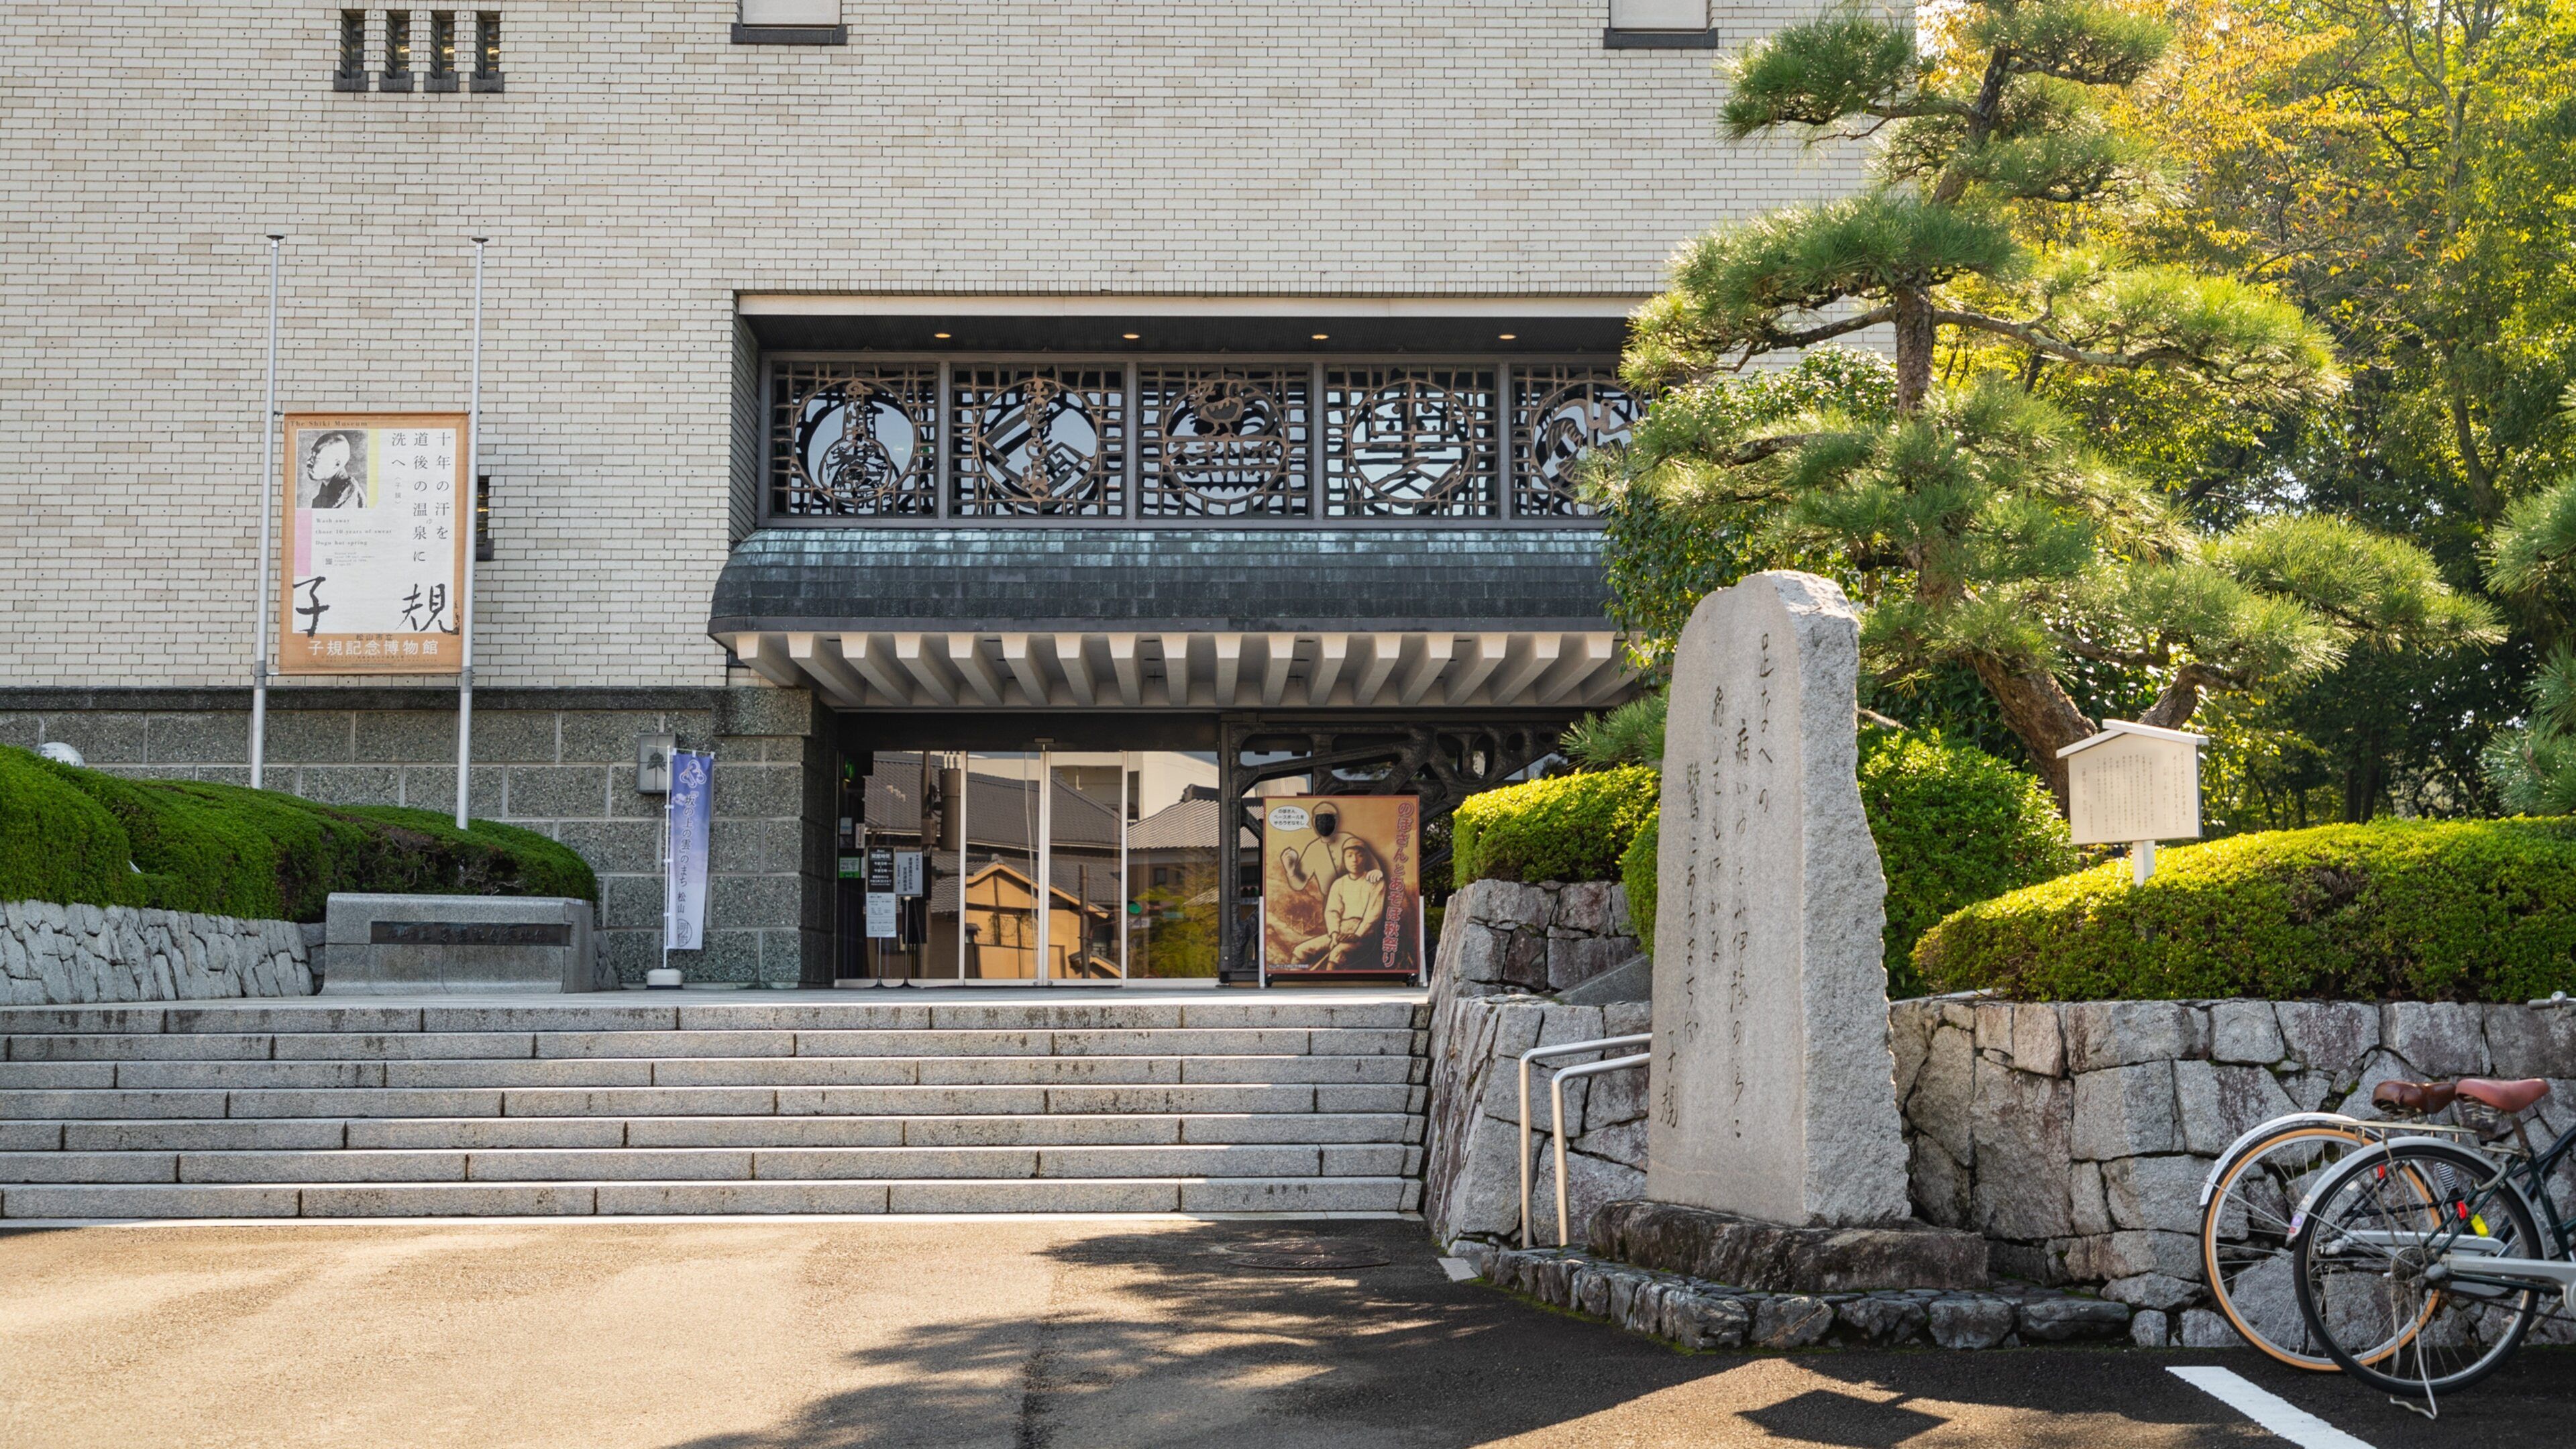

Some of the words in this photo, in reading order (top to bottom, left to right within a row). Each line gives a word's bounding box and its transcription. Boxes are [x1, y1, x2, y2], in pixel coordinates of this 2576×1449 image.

[392, 432, 406, 466] 洗へ
[413, 432, 429, 561] 道後の温泉に
[435, 432, 451, 540] 十年の汗を
[308, 639, 439, 655] 子規記念博物館
[678, 791, 699, 888] 『坂の上の雲』のまち
[1382, 802, 1414, 968] のぼさんとあそぼ秋祭り
[677, 891, 687, 914] 松山
